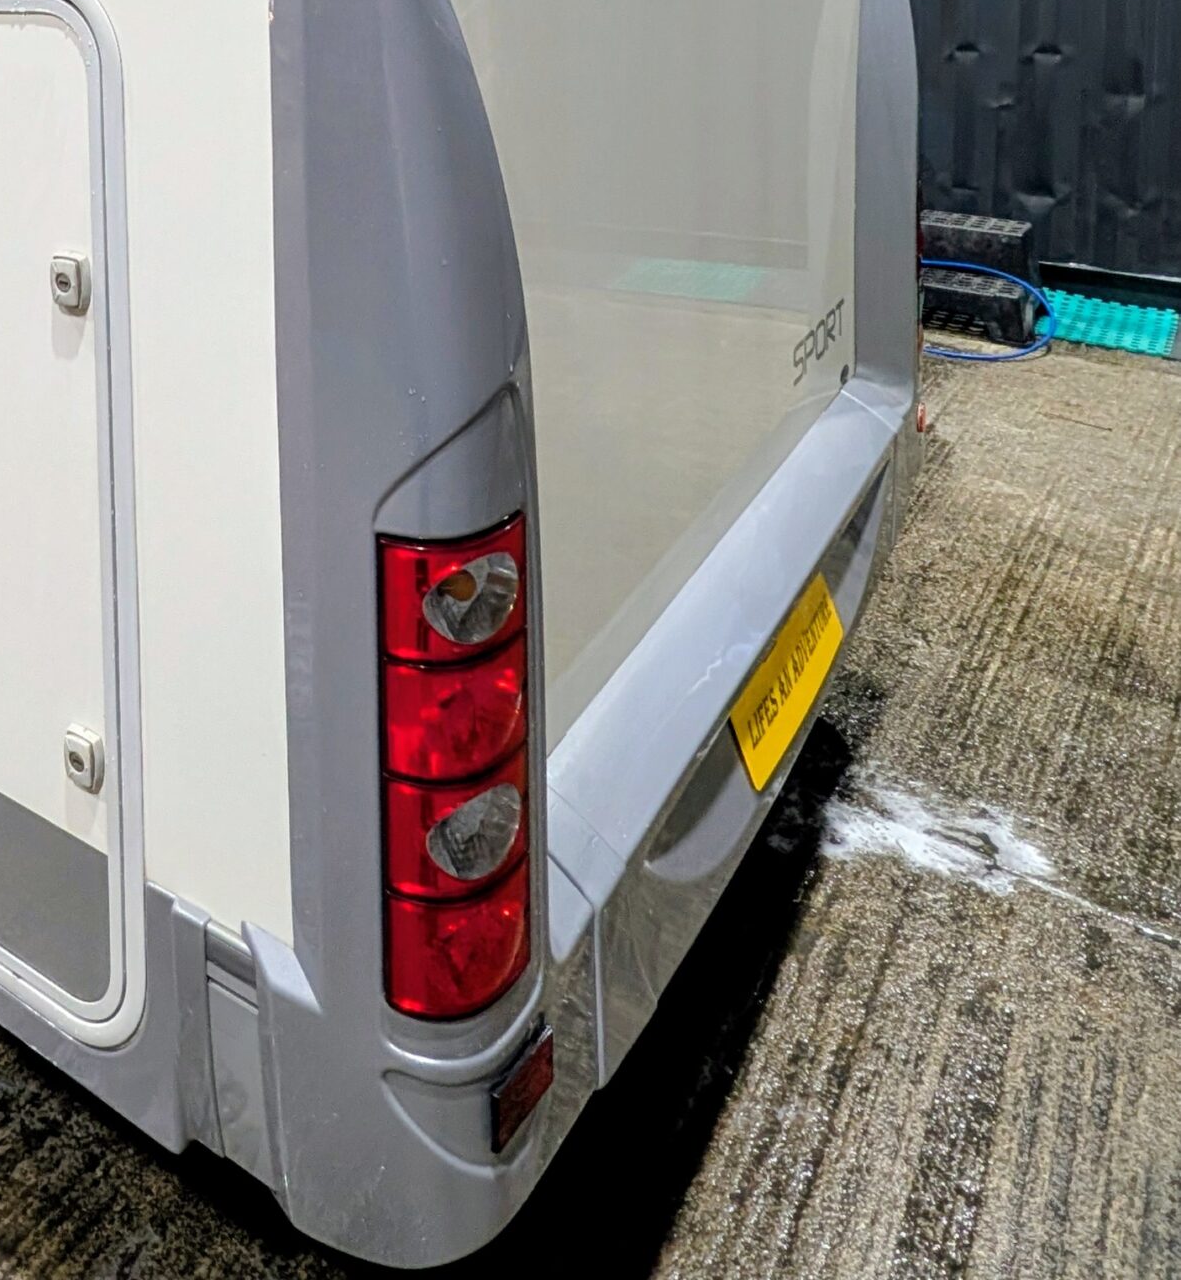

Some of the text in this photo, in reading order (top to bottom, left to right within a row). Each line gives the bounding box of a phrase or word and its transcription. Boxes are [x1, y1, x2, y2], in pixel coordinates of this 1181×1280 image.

[793, 297, 845, 387] SPORT
[747, 593, 832, 750] LIFES AN ADVENTURE
